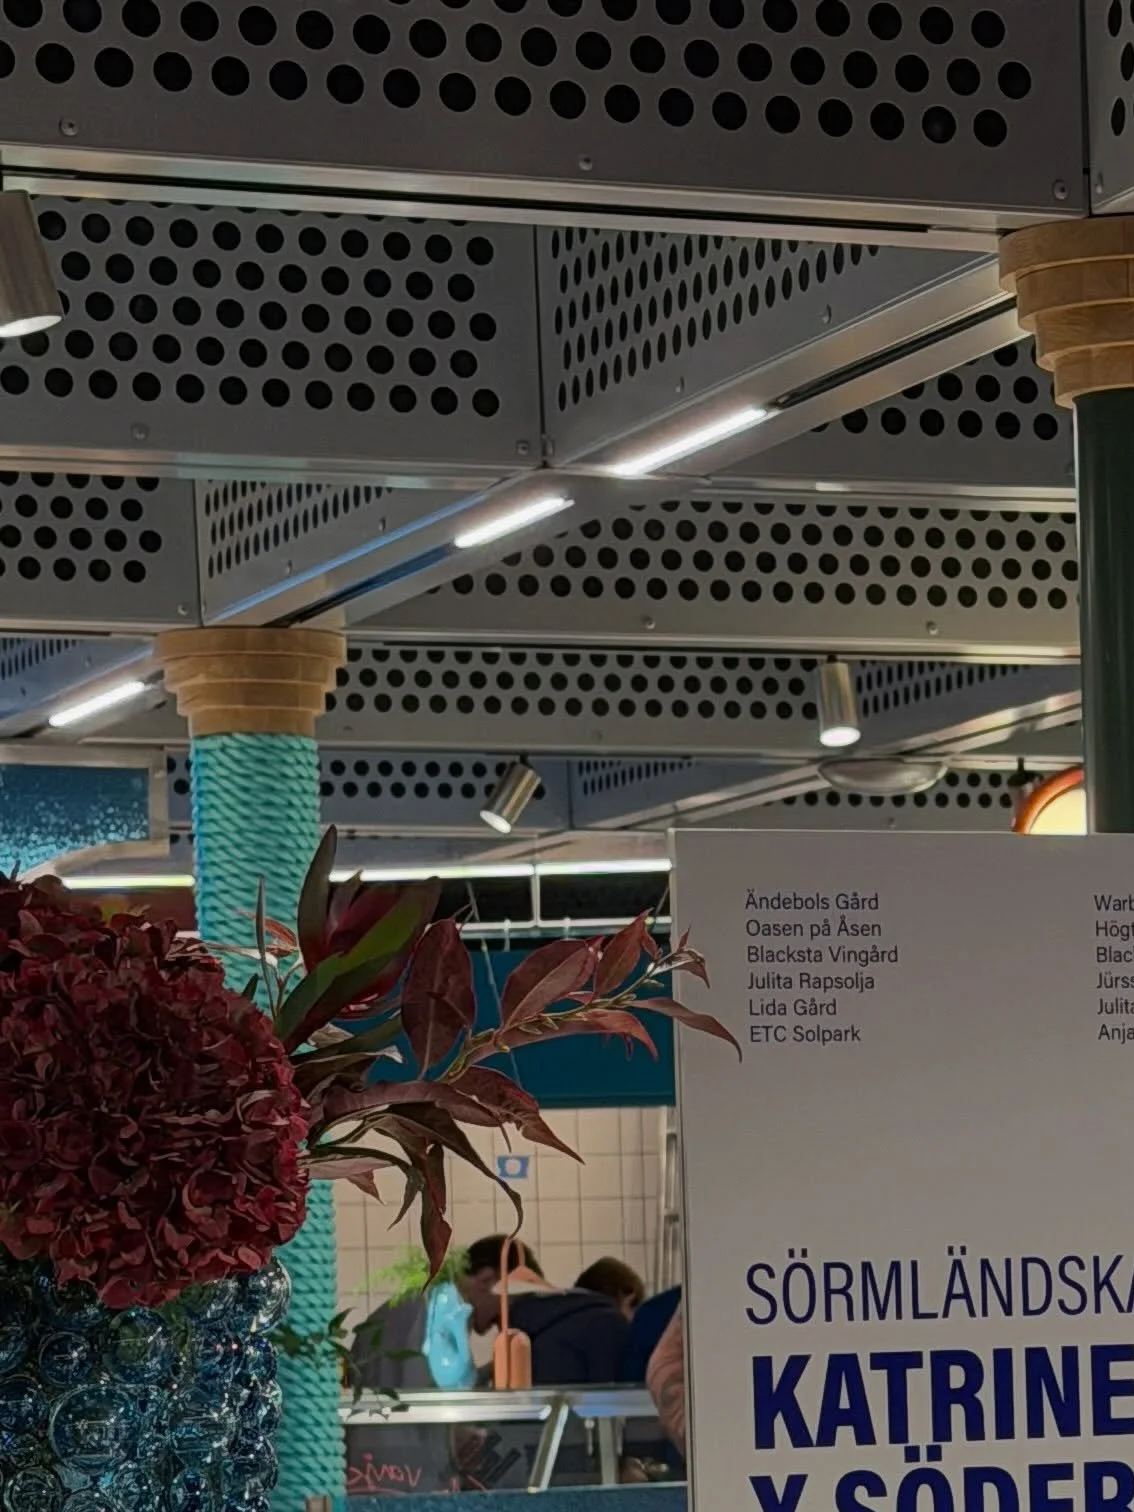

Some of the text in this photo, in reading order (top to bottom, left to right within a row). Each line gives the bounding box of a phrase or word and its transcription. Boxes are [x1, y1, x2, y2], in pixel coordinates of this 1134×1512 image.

[746, 889, 879, 910] Ändebols Gård
[746, 915, 882, 940] Oasen på Åsen
[747, 945, 899, 967] Blacksta Vingård
[748, 972, 875, 993] Julita Rapsolja
[749, 997, 837, 1016] Lida Gård
[750, 1024, 862, 1046] ETC Solpark
